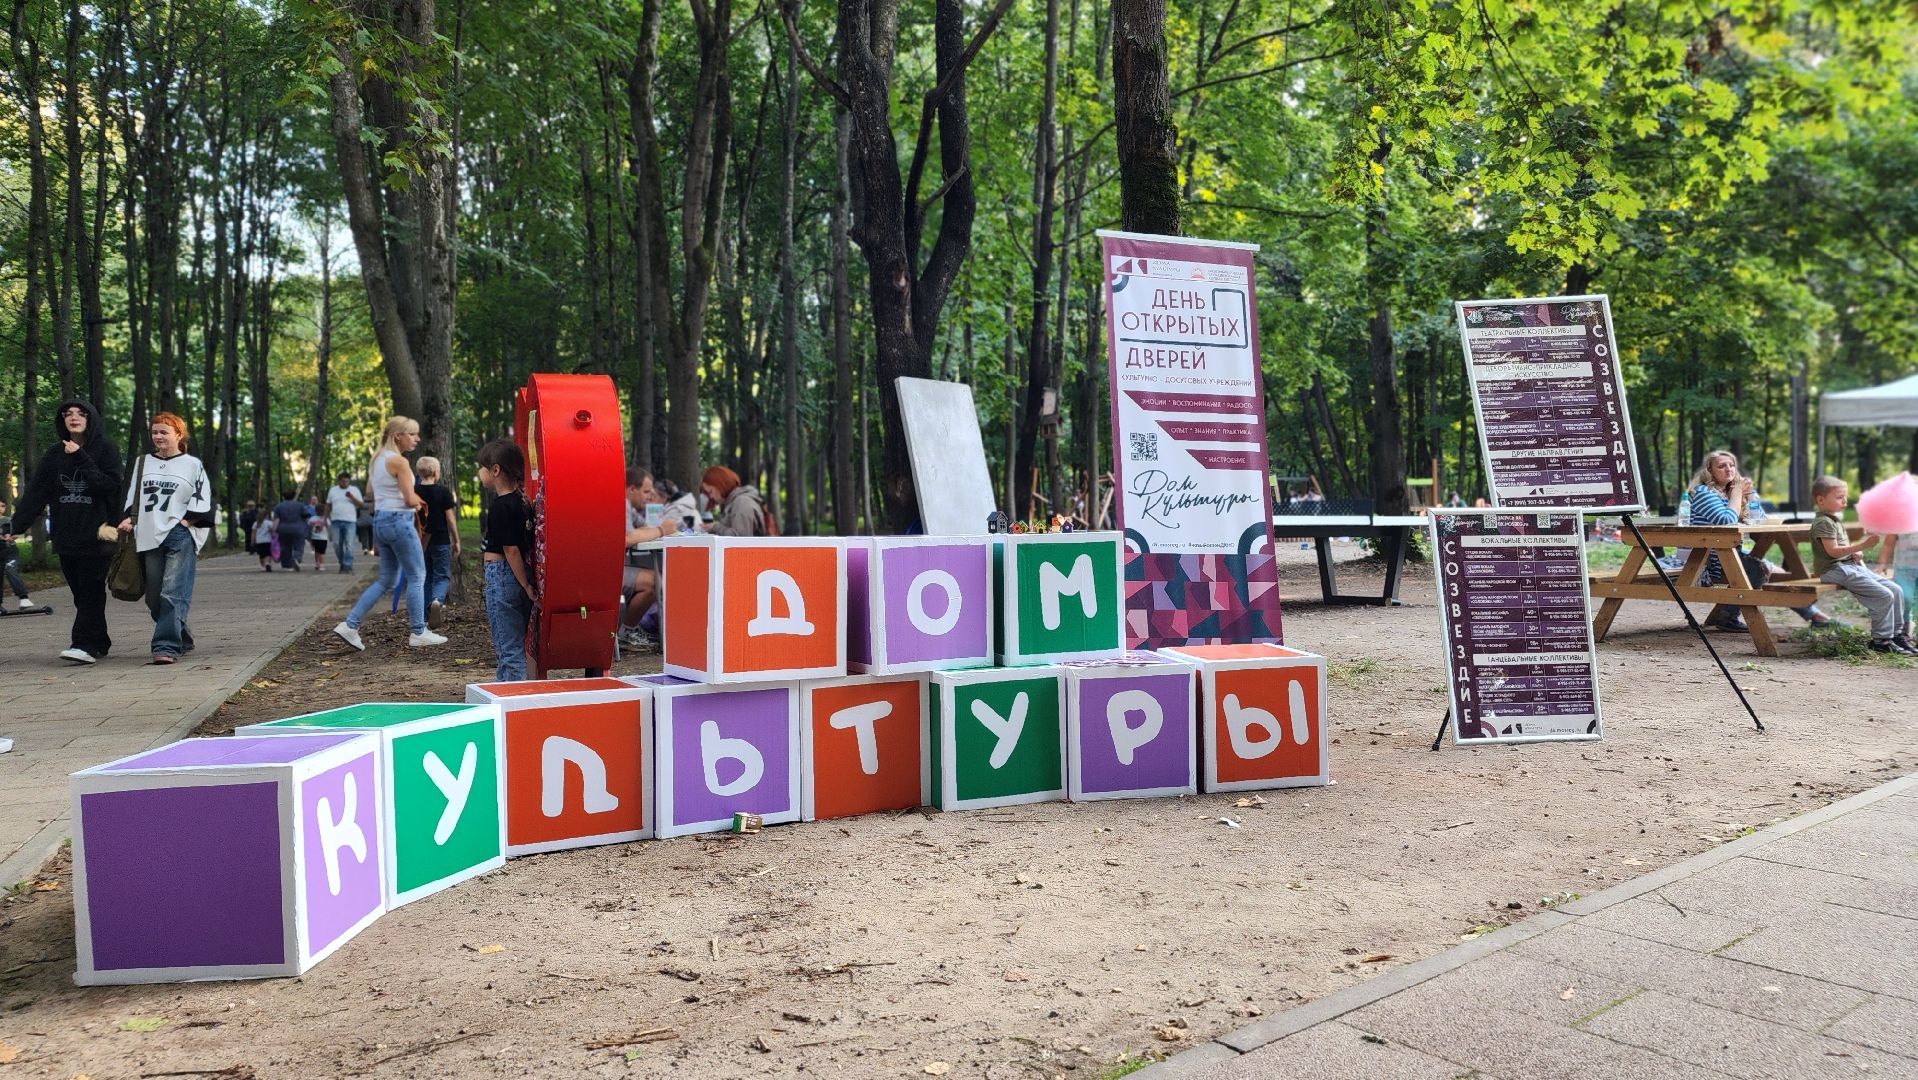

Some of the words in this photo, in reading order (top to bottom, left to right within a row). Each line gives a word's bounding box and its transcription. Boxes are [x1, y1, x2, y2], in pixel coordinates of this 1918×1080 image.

[1152, 288, 1206, 310] ДЕНЬ
[1122, 311, 1240, 337] ОТКРЫТЫХ
[1480, 329, 1526, 337] ТЕАТРАЛЬНЫЕ
[1527, 327, 1573, 335] КОЛЛЕКТИВЫ
[1126, 345, 1206, 370] ДВЕРЕЙ
[1121, 374, 1158, 383] КУЛЬТУРНО
[1165, 376, 1207, 386] ДОСУГОВЫХ
[1209, 378, 1252, 388] УЧРЕЖДЕНИЙ
[1514, 370, 1554, 378] ИСКУССТВО
[1141, 398, 1167, 406] ЭМОЦИИ
[1592, 324, 1629, 494] СОЗВЕЗДИЕ
[1222, 428, 1252, 436] ПРАКТИКА
[1208, 456, 1246, 464] НАСТРОЕНИЕ
[1511, 450, 1536, 458] ДРУГИЕ
[1537, 448, 1584, 456] НАПРАВЛЕНИЯ
[1128, 469, 1198, 497] Дом
[143, 486, 177, 513] 37
[1141, 492, 1260, 529] Культуры
[748, 554, 1098, 637] ДОМ
[1444, 541, 1473, 724] СОЗВЕЗДИЕ
[1487, 655, 1538, 663] ТАНЦЕВАЛЬНЫЕ
[1539, 654, 1584, 662] КОЛЛЕКТИВЫ
[316, 678, 1309, 896] КУЛЬТУРЫ
